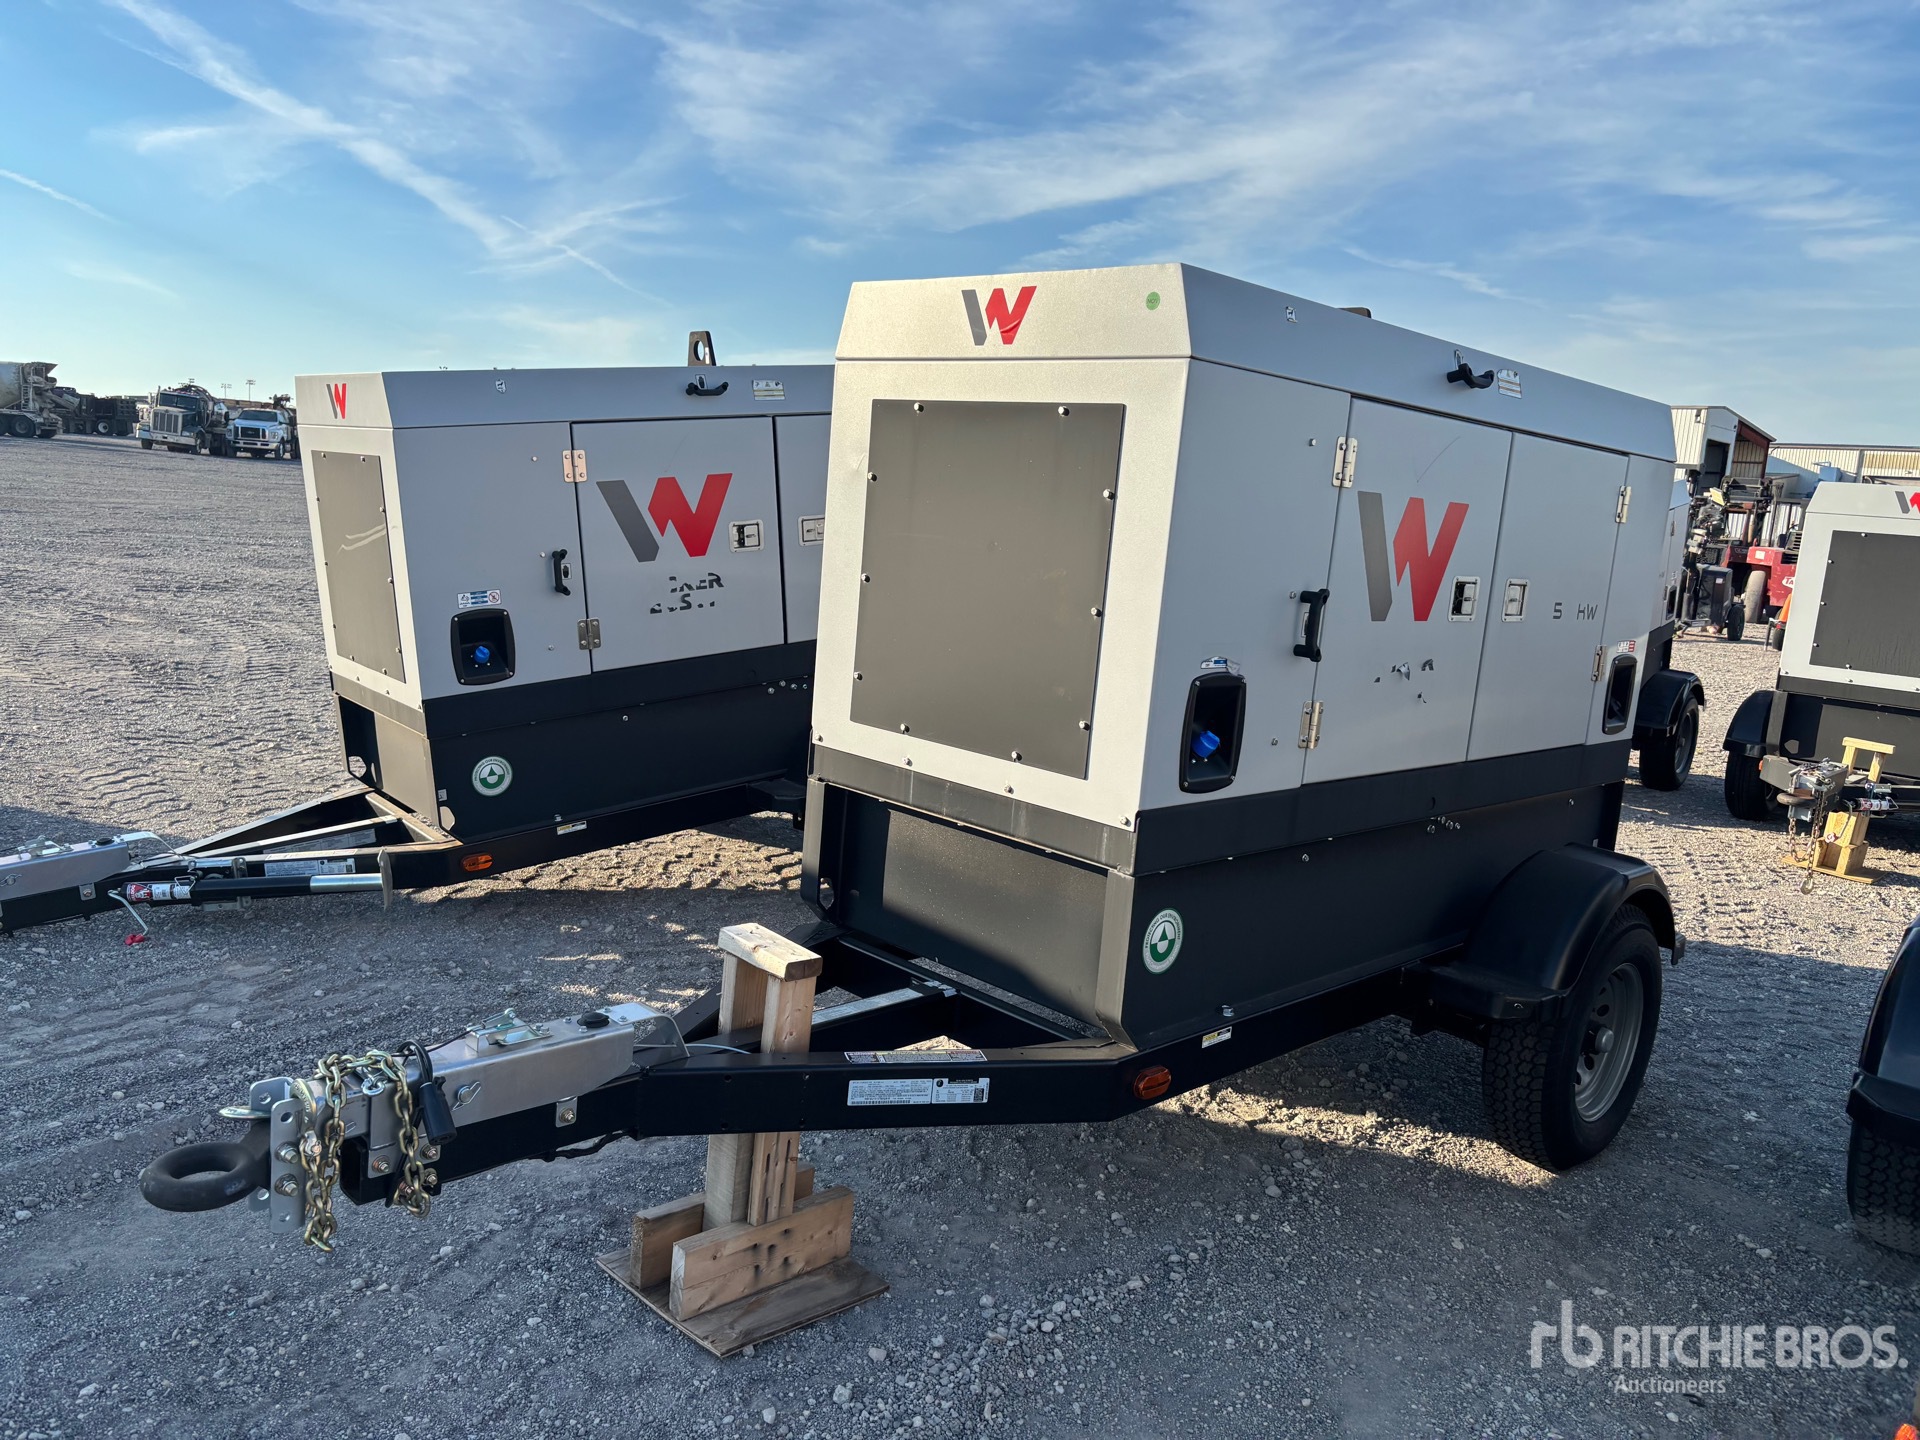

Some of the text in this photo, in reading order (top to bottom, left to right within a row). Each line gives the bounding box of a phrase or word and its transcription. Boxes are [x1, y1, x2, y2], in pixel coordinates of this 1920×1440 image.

[961, 286, 1037, 346] W
[596, 473, 732, 562] W
[1358, 491, 1469, 622] W
